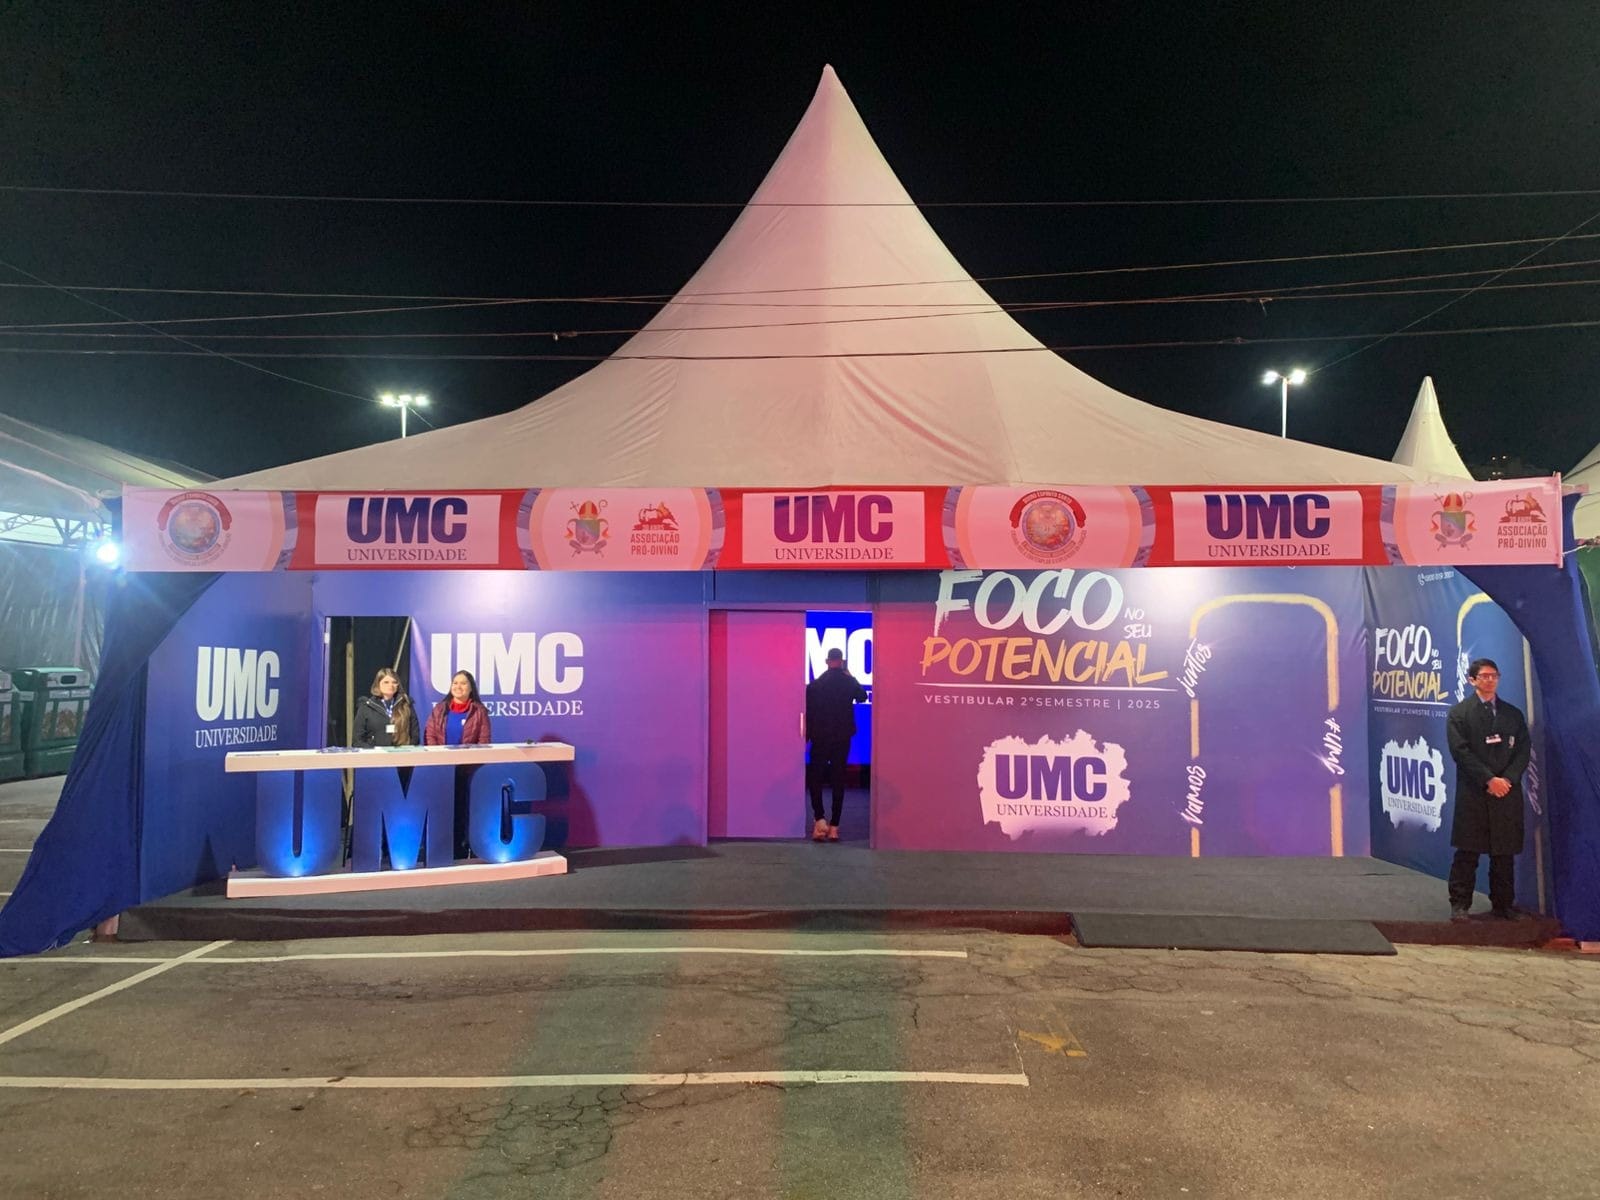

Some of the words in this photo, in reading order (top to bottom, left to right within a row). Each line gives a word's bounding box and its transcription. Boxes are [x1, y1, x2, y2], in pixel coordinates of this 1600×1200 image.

[346, 497, 468, 544] UMC
[773, 494, 894, 543] UMC
[1204, 494, 1330, 540] UMC
[630, 531, 680, 544] ASSOCIAÇÃO
[1497, 523, 1548, 537] ASSOCIAÇÃO
[346, 548, 467, 561] UNIVERSIDADE
[631, 543, 679, 555] PRÓ-DIVINO
[774, 547, 894, 560] UNIVERSIDADE
[1207, 544, 1331, 558] UNIVERSIDADE
[1497, 537, 1547, 549] PRÓ-DIVINO
[933, 569, 1124, 637] FOCO
[1124, 607, 1145, 620] NO
[1123, 623, 1152, 639] SEU
[1375, 624, 1432, 670] FOCO
[431, 632, 584, 695] UMC
[919, 636, 1168, 687] POTENCIAL
[1176, 638, 1212, 698] juntos
[196, 646, 280, 722] UMC
[1372, 670, 1449, 702] POTENCIAL
[432, 700, 584, 716] ERSIDADE
[924, 694, 1015, 706] VESTIBULAR
[1127, 699, 1161, 710] 2025
[195, 724, 277, 748] UNIVERSIDADE
[995, 754, 1107, 802] UMC
[1386, 755, 1435, 802] UMC
[996, 803, 1108, 818] UNIVERSIDADE
[1387, 797, 1437, 817] UNIVERSIDADE
[256, 762, 547, 877] UMC
